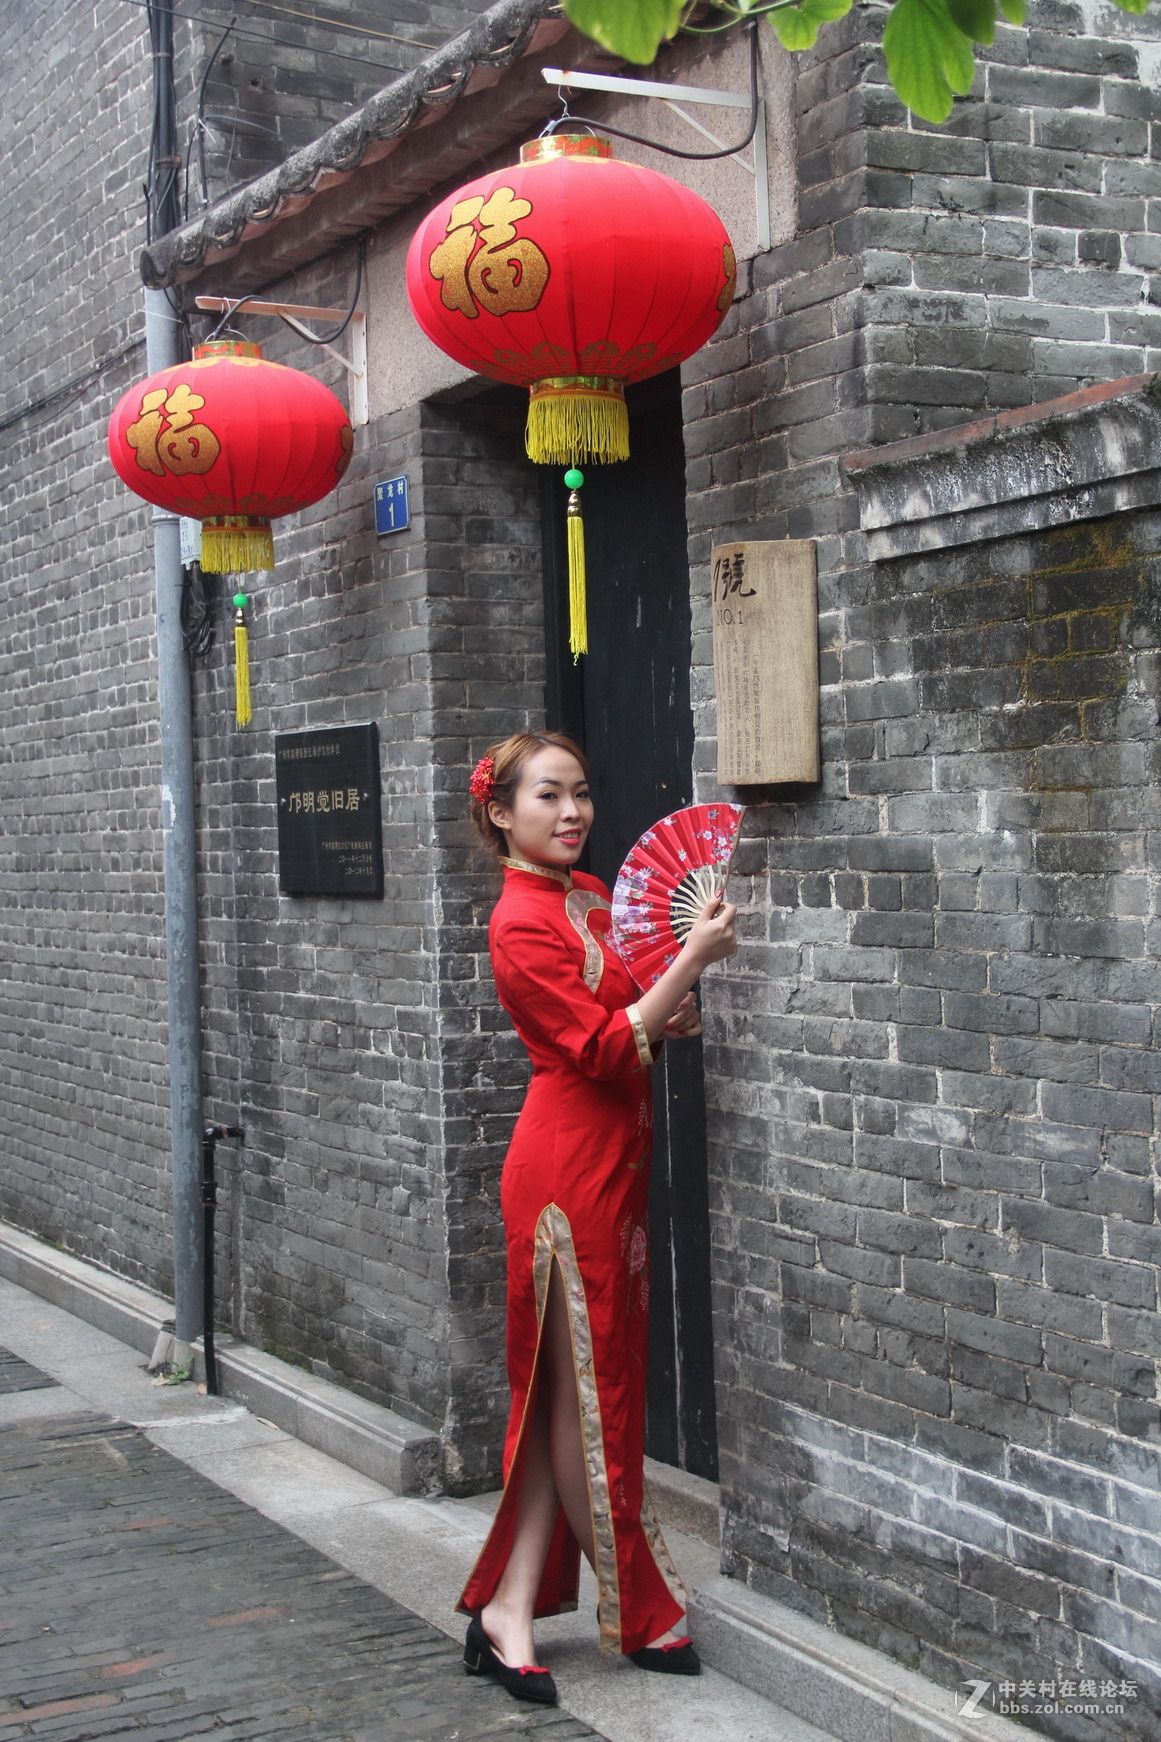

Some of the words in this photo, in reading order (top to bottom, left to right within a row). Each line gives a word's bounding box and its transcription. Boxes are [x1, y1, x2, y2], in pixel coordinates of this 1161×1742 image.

[429, 186, 551, 319] 福
[126, 383, 221, 477] 福
[388, 502, 395, 527] 1
[288, 788, 361, 814] 邝明觉旧居
